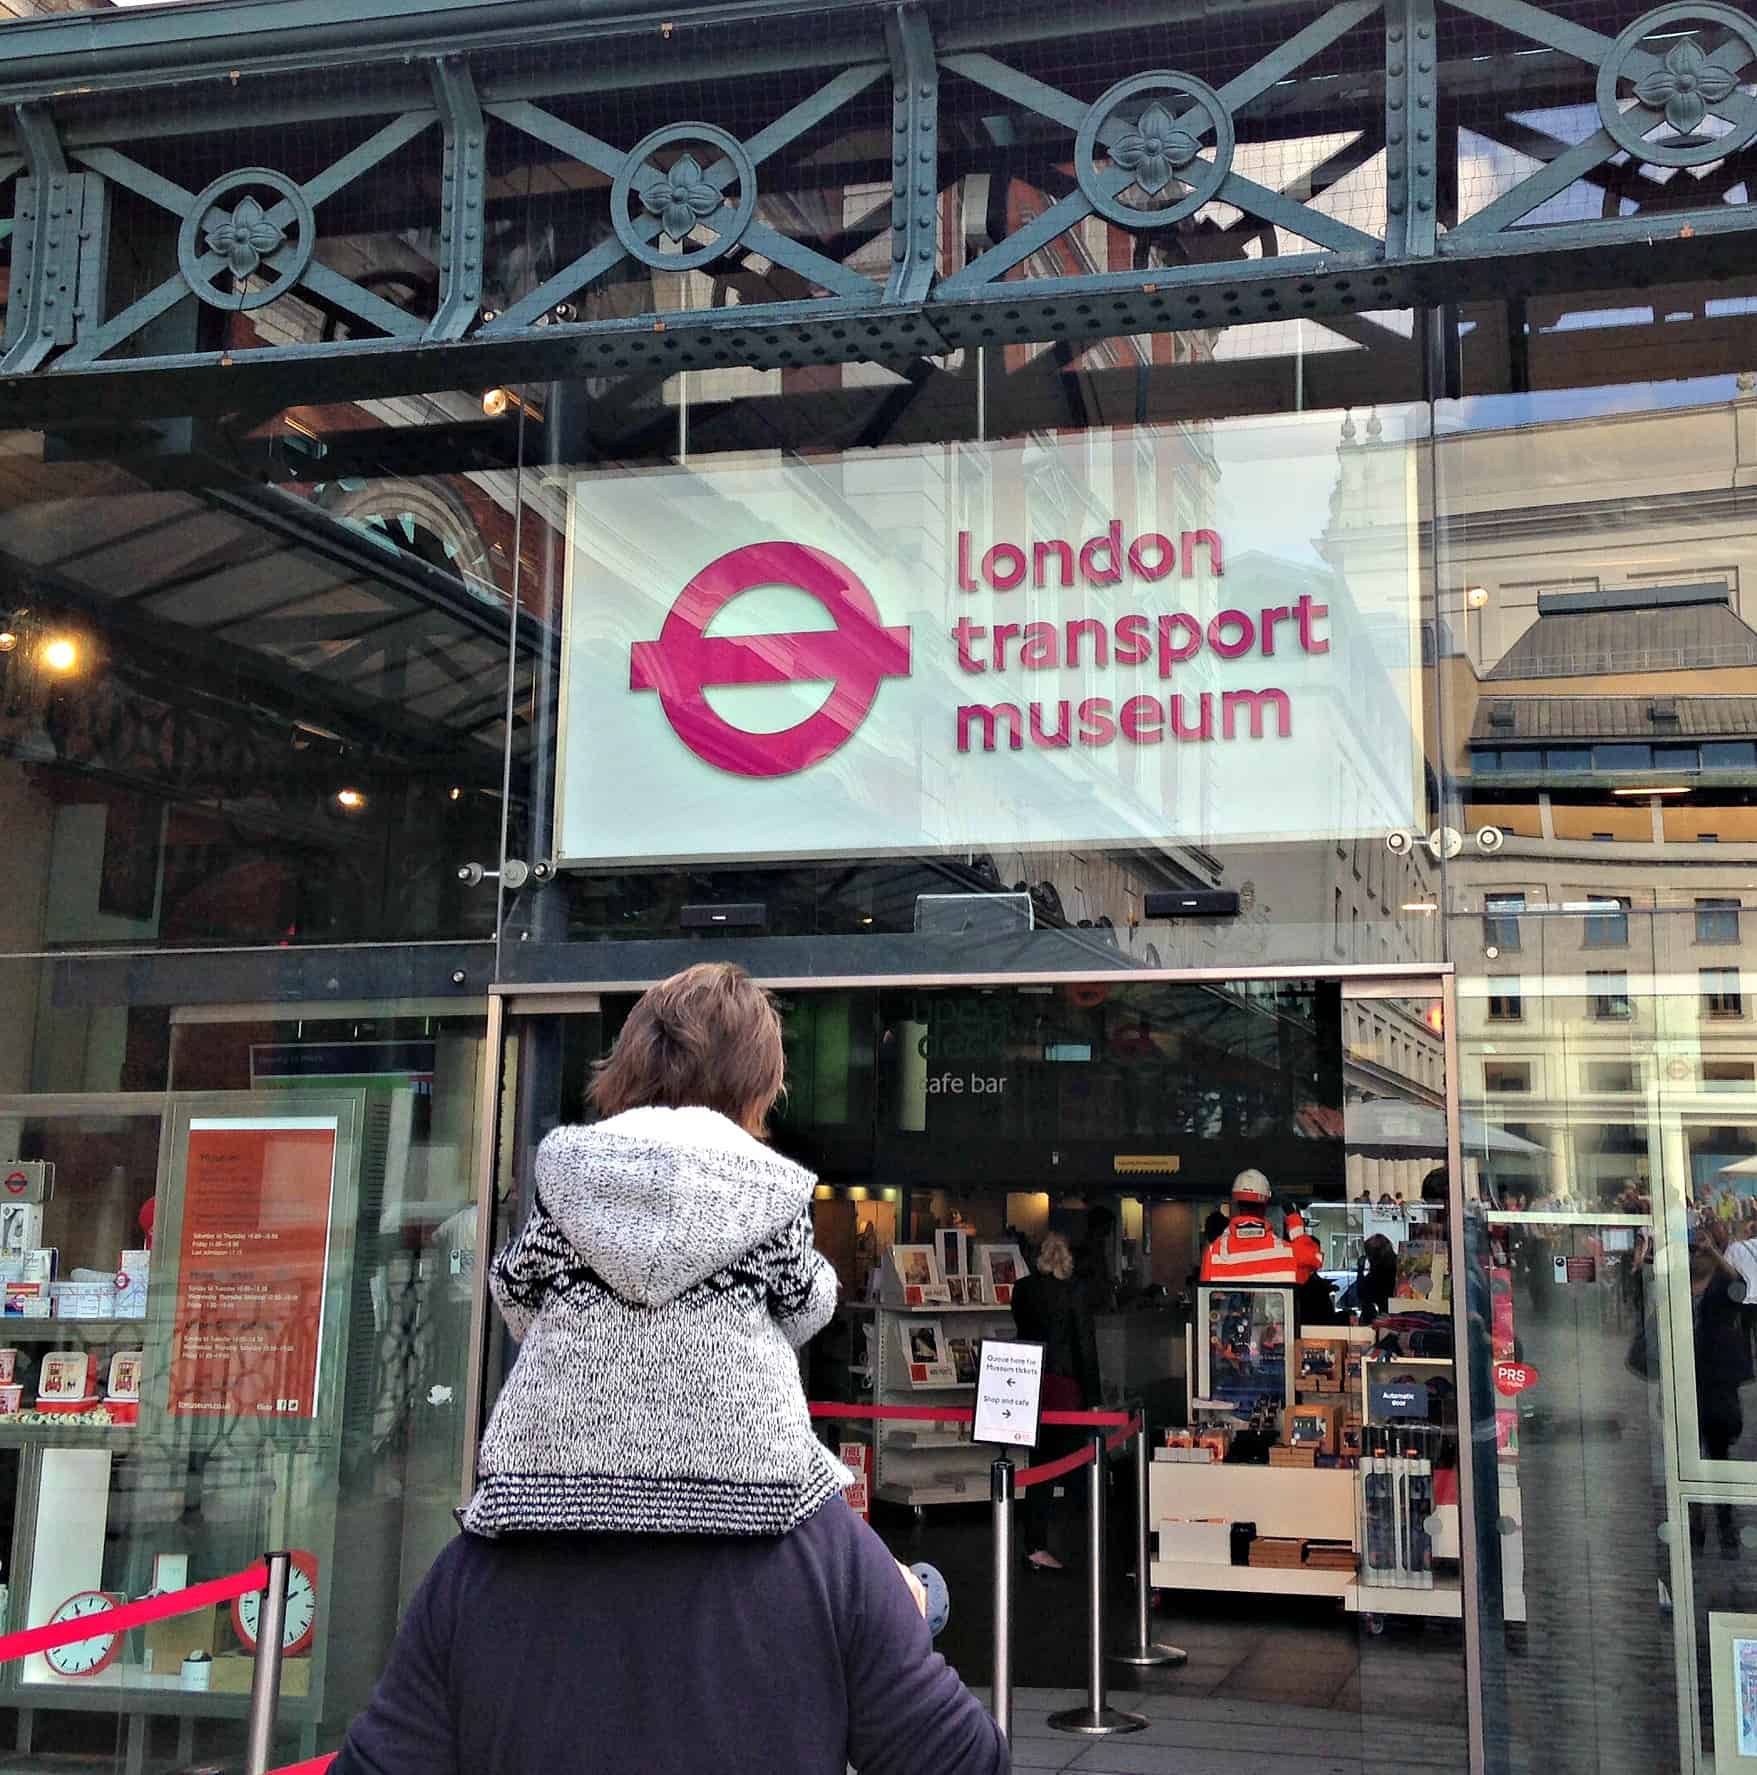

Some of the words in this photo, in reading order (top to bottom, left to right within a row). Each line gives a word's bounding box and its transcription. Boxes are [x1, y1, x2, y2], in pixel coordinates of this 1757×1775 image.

[957, 519, 1225, 593] london
[951, 594, 1330, 679] transport
[955, 687, 1293, 753] museum
[971, 1072, 1008, 1093] bar
[986, 1363, 1014, 1373] Museum
[1015, 1367, 1038, 1376] tickets
[1498, 1367, 1527, 1382] PRS
